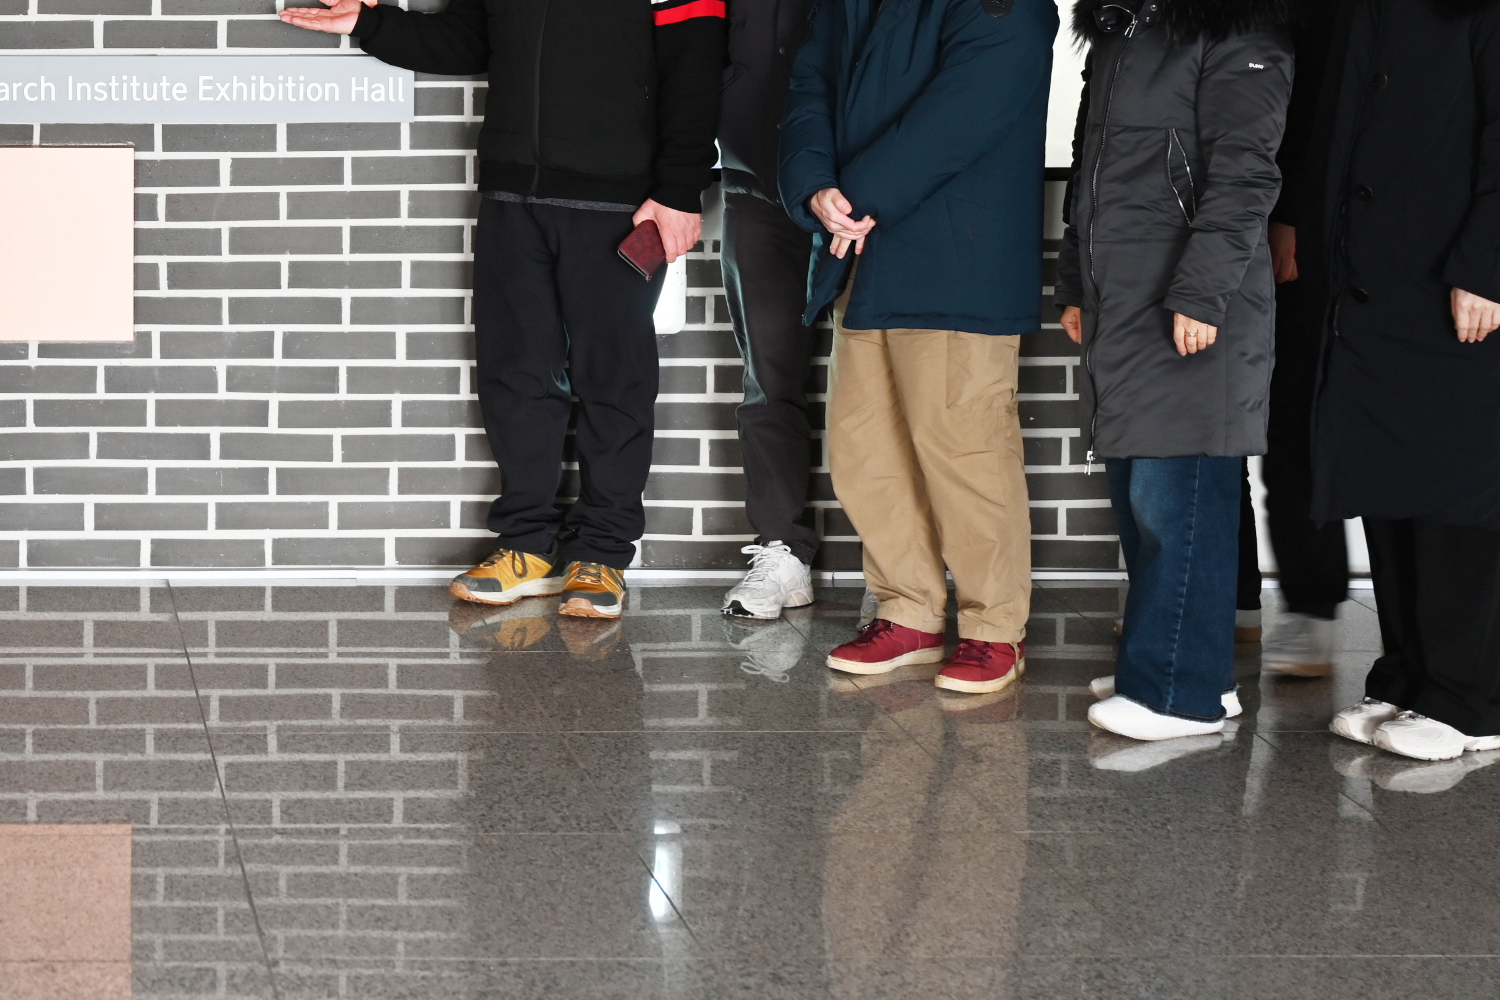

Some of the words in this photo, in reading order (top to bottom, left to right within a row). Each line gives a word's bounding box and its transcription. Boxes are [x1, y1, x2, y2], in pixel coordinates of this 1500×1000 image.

[68, 75, 187, 102] Institute
[198, 75, 340, 102] Exhibition
[351, 76, 405, 103] Hall
